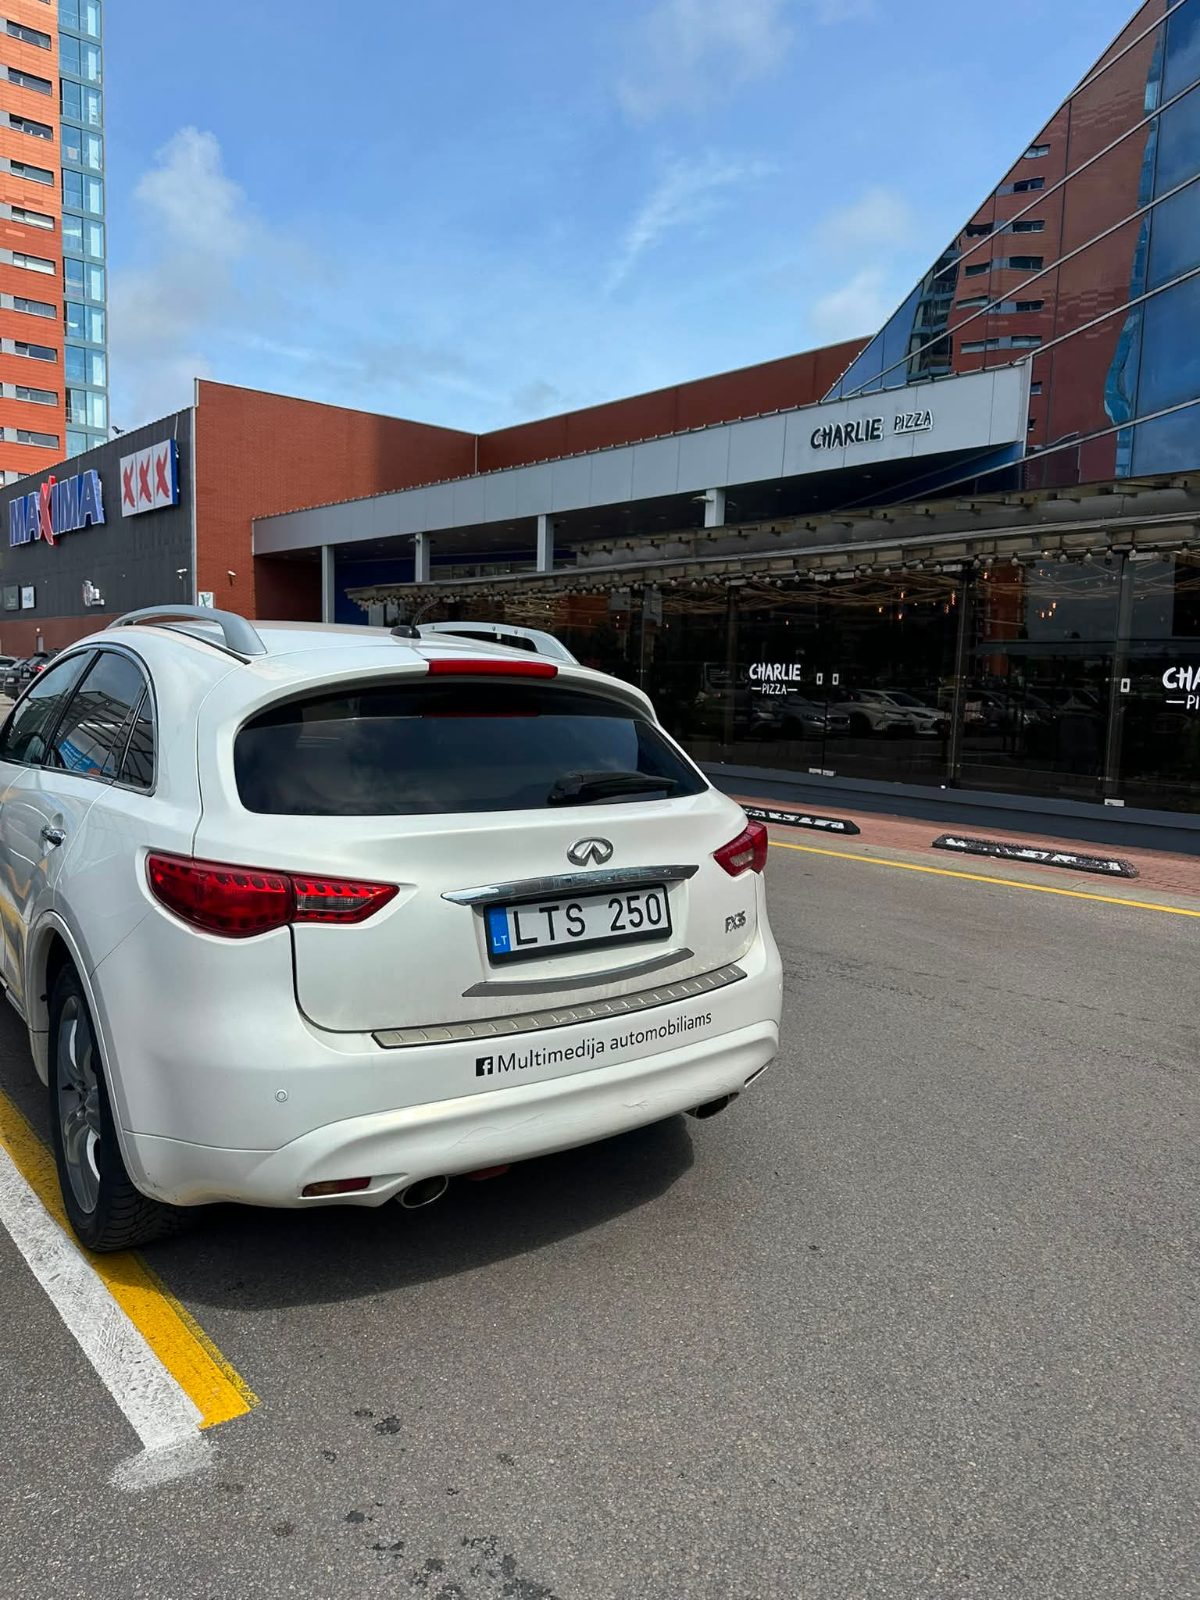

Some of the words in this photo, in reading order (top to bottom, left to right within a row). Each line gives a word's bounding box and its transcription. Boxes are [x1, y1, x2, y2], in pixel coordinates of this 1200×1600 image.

[810, 417, 883, 449] CHARLIE
[894, 409, 933, 431] PIZZA
[123, 448, 170, 508] XXX
[9, 469, 104, 546] MAXIMA
[749, 662, 802, 682] CHARLIE
[761, 683, 788, 695] PIZZA
[1186, 694, 1200, 710] PI
[493, 934, 508, 947] LT
[512, 903, 586, 946] LTS
[608, 893, 662, 932] 250
[497, 1038, 605, 1073] Multimedija
[610, 1011, 713, 1050] automobiliams
